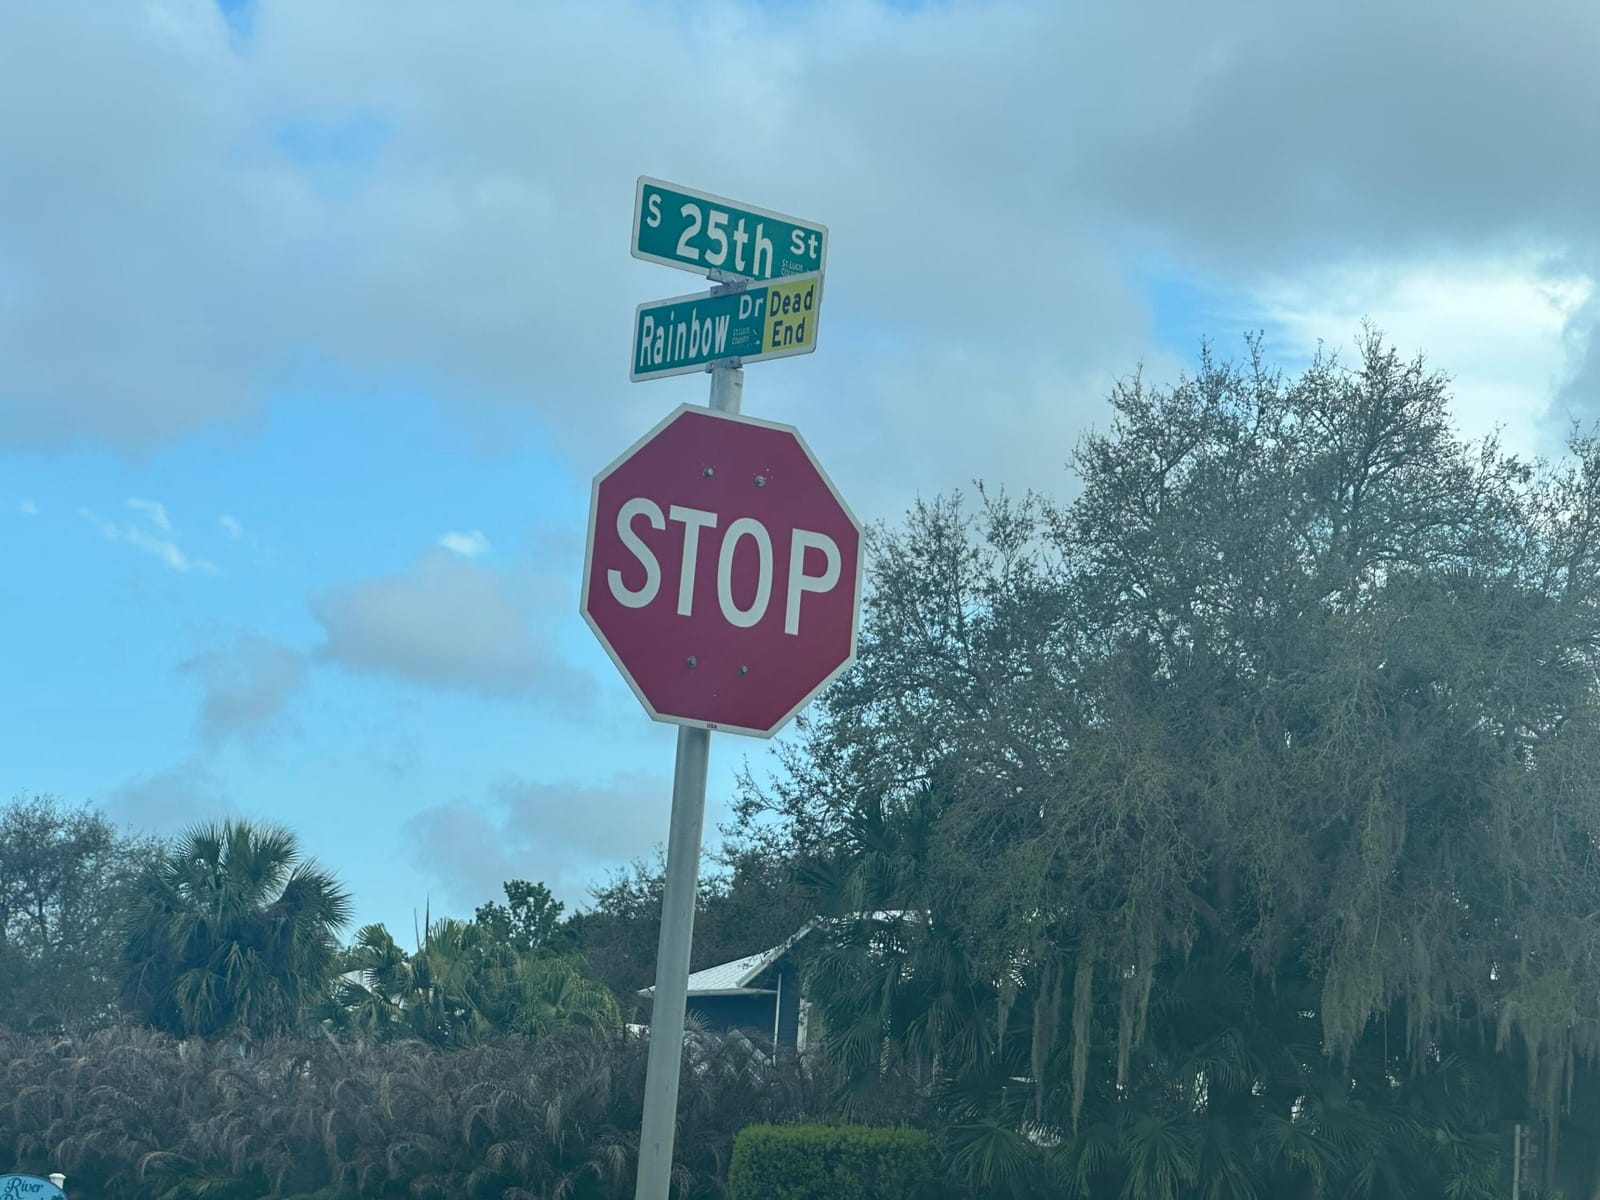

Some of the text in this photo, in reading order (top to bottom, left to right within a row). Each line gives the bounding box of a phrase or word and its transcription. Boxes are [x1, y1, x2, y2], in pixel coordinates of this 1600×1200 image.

[646, 193, 819, 279] S 25th St
[639, 295, 764, 367] Rainbow Dr
[769, 284, 814, 317] Dead
[771, 319, 806, 348] End
[607, 497, 842, 636] STOP
